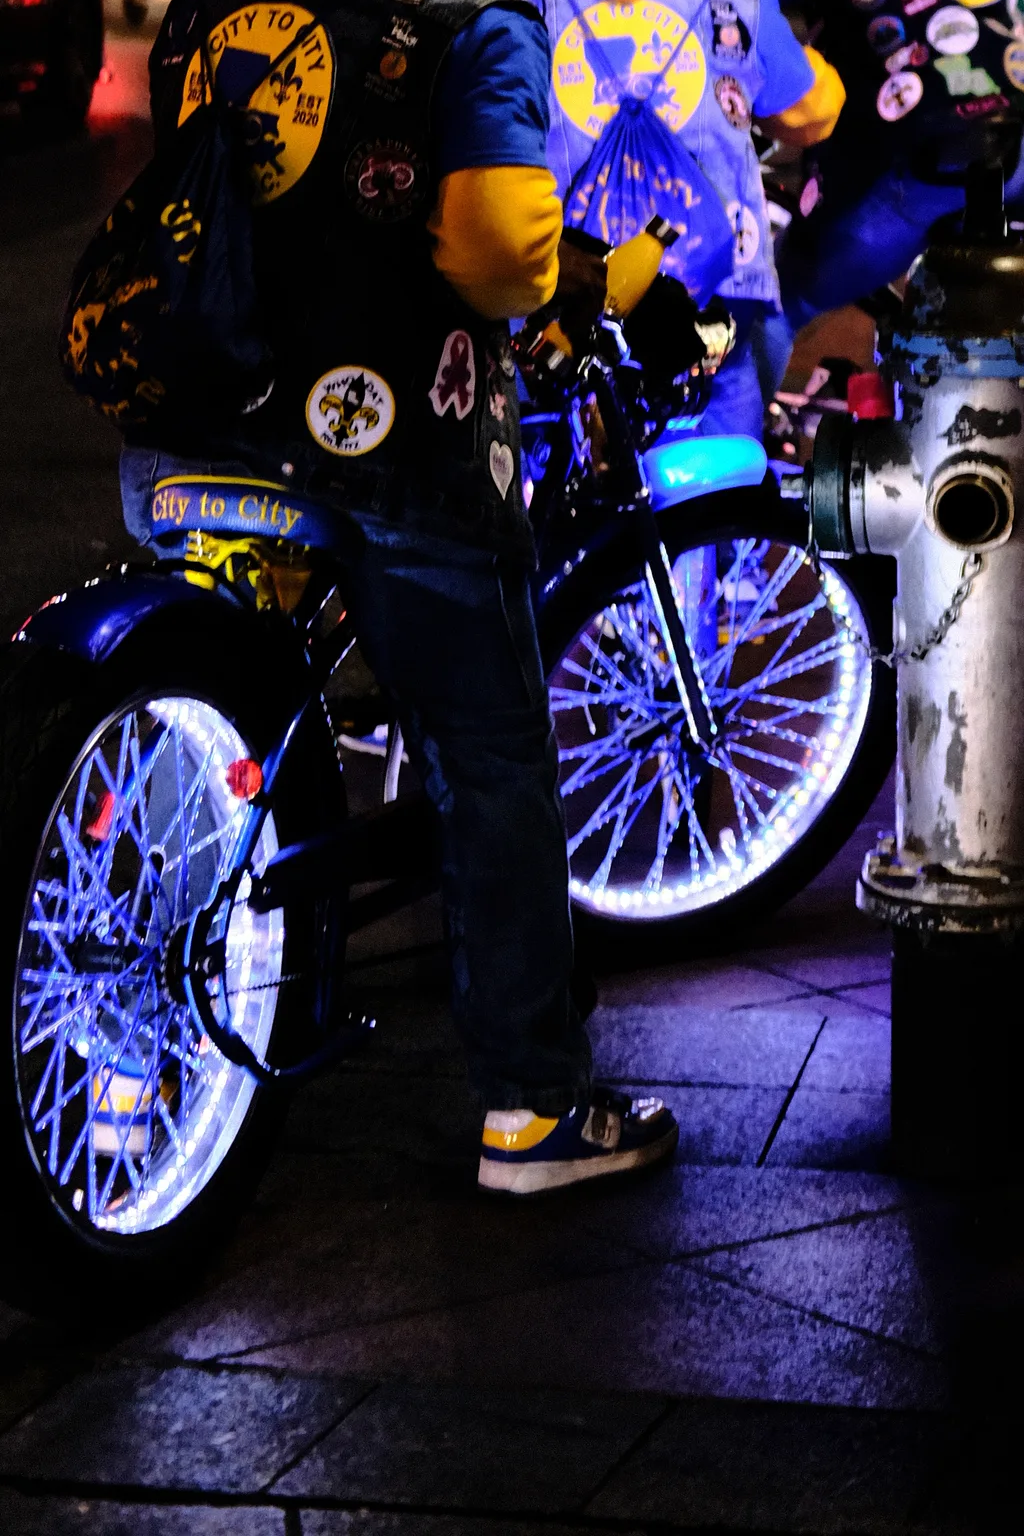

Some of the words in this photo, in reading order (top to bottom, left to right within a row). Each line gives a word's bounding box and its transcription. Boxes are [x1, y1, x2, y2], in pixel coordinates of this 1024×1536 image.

[209, 10, 258, 54] CITY
[267, 9, 295, 32] TO
[566, 11, 600, 49] CIY
[609, 4, 635, 18] TO
[642, 7, 685, 37] CITY
[292, 110, 320, 128] 2020
[297, 93, 325, 110] EST
[152, 489, 191, 526] City
[200, 490, 226, 518] to
[237, 493, 304, 536] City
